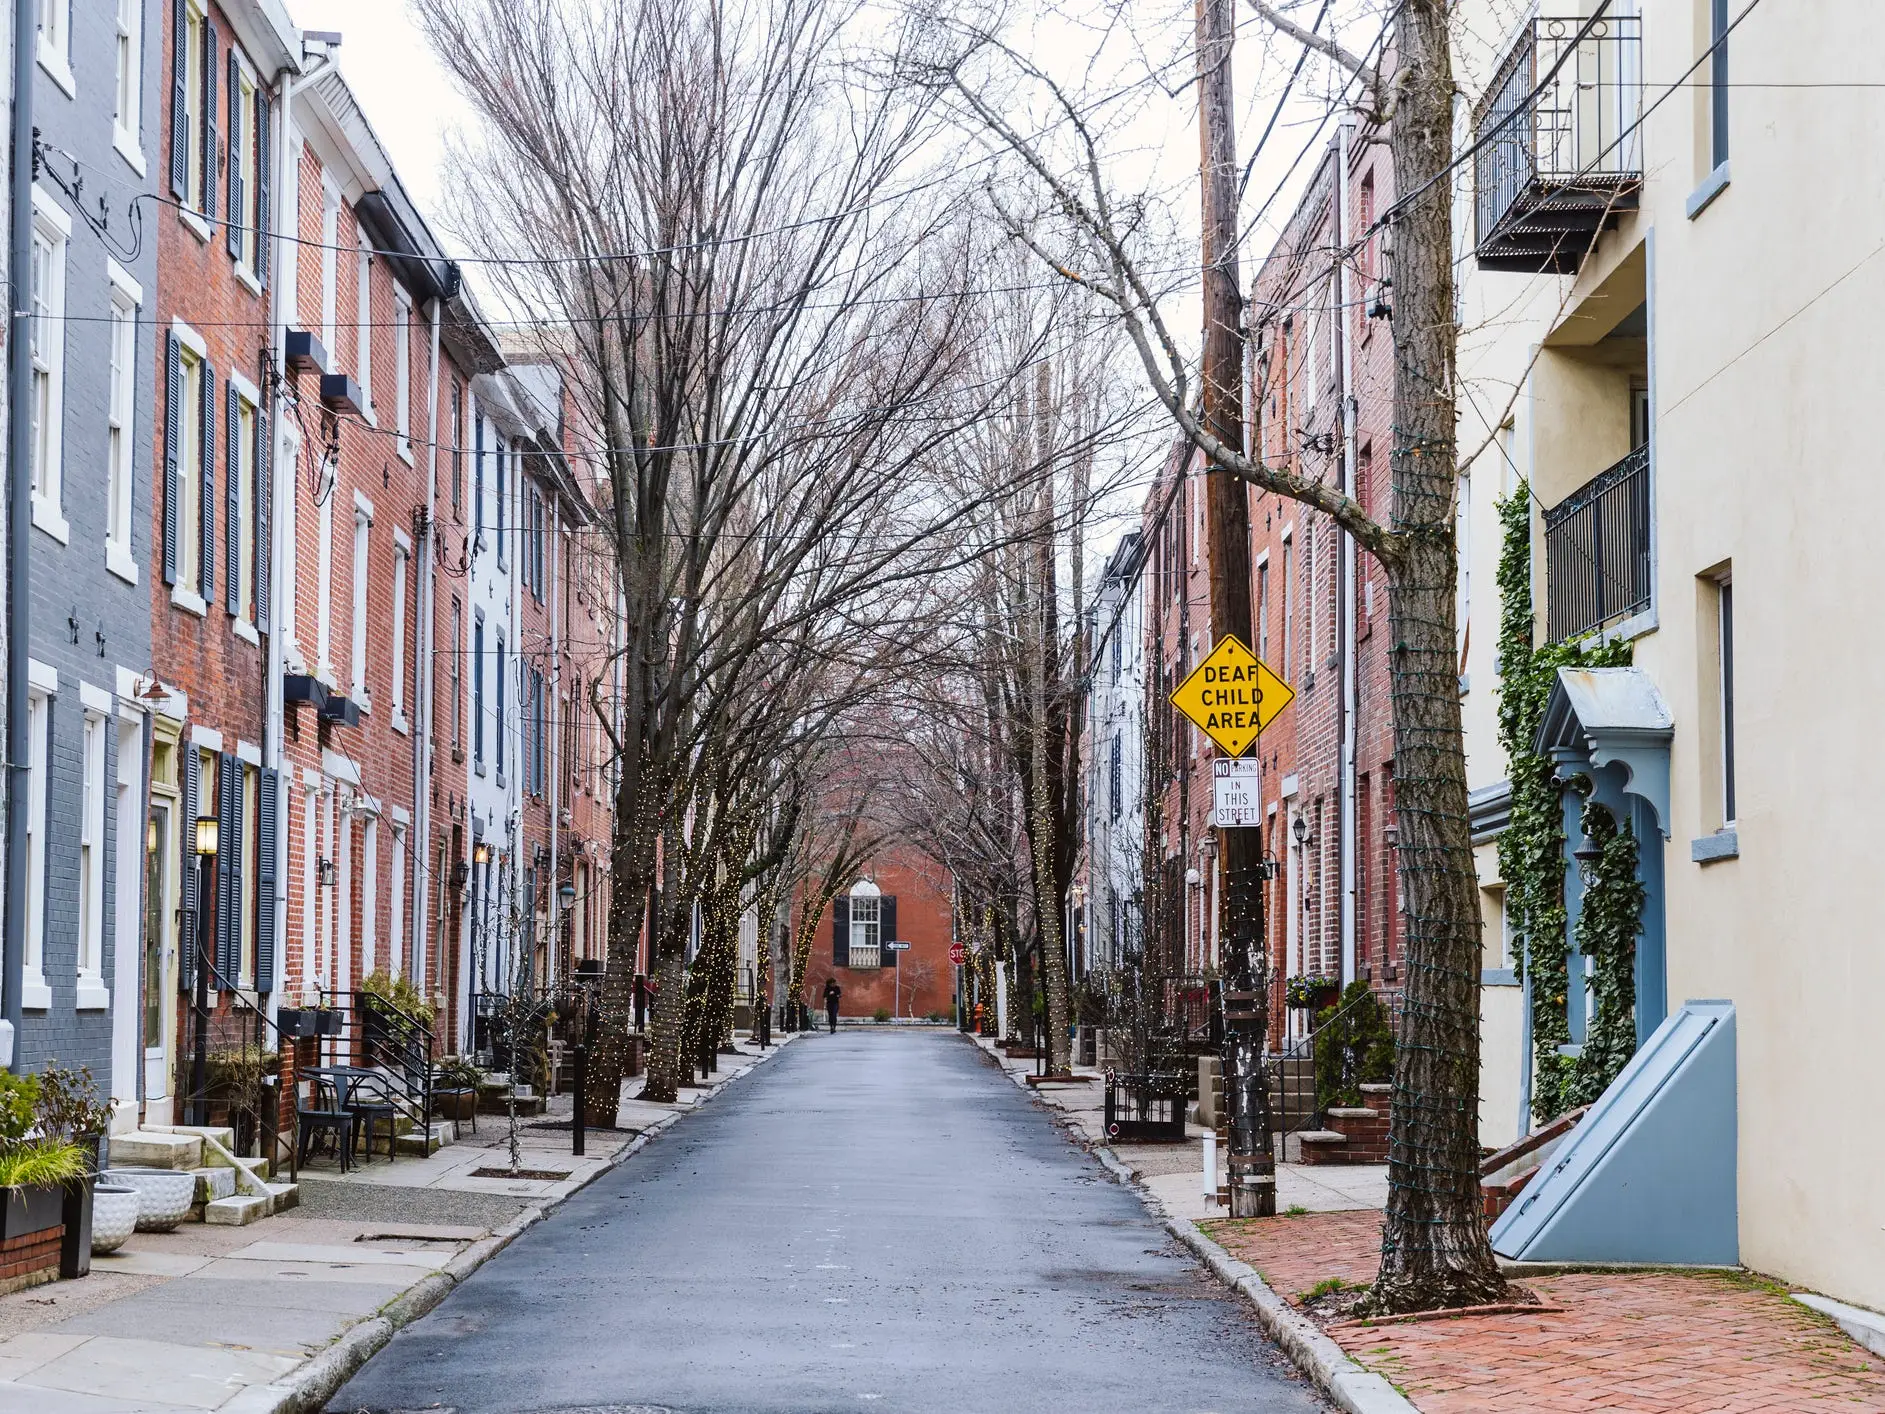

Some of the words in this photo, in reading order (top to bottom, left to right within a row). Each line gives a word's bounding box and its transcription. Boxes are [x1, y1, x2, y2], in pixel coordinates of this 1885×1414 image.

[1205, 665, 1258, 683] DEAF
[1201, 688, 1263, 706] CHILD
[1206, 711, 1261, 729] AREA
[1215, 762, 1229, 776] NO
[1231, 781, 1241, 790] IN
[1224, 792, 1249, 805] THIS
[1219, 808, 1255, 821] STREET
[950, 949, 965, 959] STO
